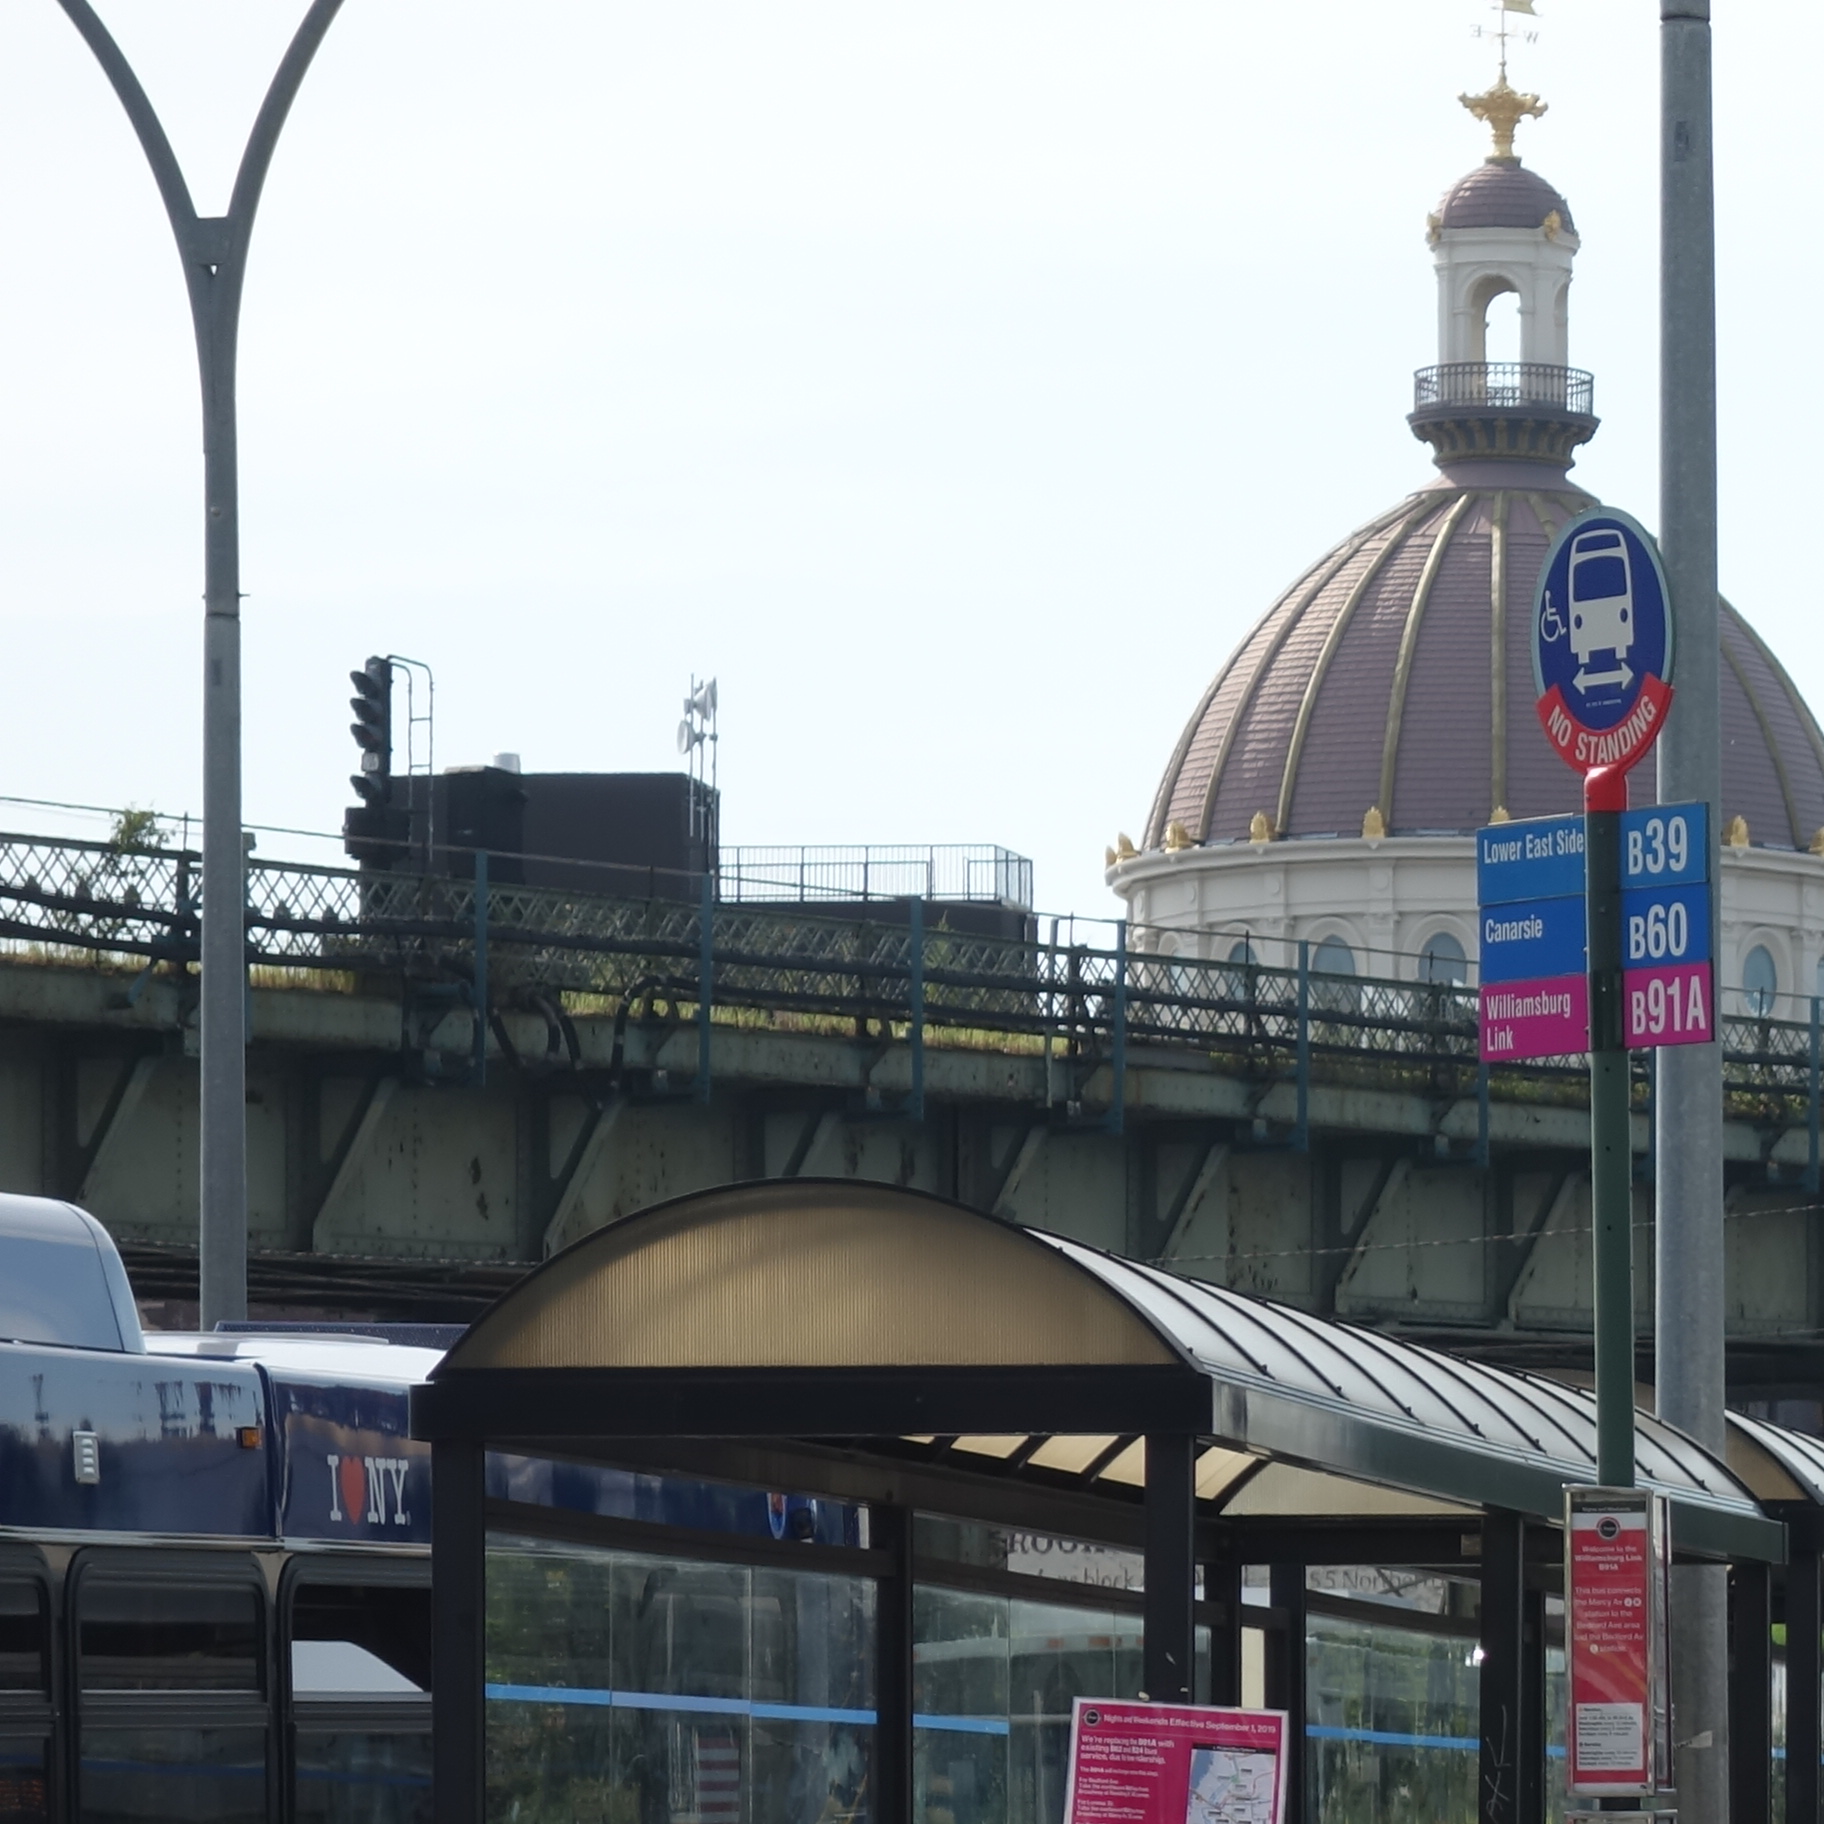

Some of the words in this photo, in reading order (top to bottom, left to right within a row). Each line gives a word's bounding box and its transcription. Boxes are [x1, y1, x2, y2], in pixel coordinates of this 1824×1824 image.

[1548, 704, 1573, 747] NO
[1575, 695, 1657, 764] STANDING
[1483, 839, 1522, 864] Lower
[1525, 832, 1553, 859] East
[1556, 828, 1584, 855] Side
[1628, 816, 1688, 875] B39
[1485, 914, 1543, 944] Canarsie
[1630, 902, 1688, 960] B60
[1486, 990, 1570, 1020] Williamsburg
[1631, 975, 1707, 1036] B91A
[1487, 1025, 1513, 1051] Link
[364, 1456, 409, 1525] NY
[1170, 1718, 1204, 1729] Effective
[1206, 1720, 1249, 1732] September
[1257, 1725, 1276, 1734] 2019
